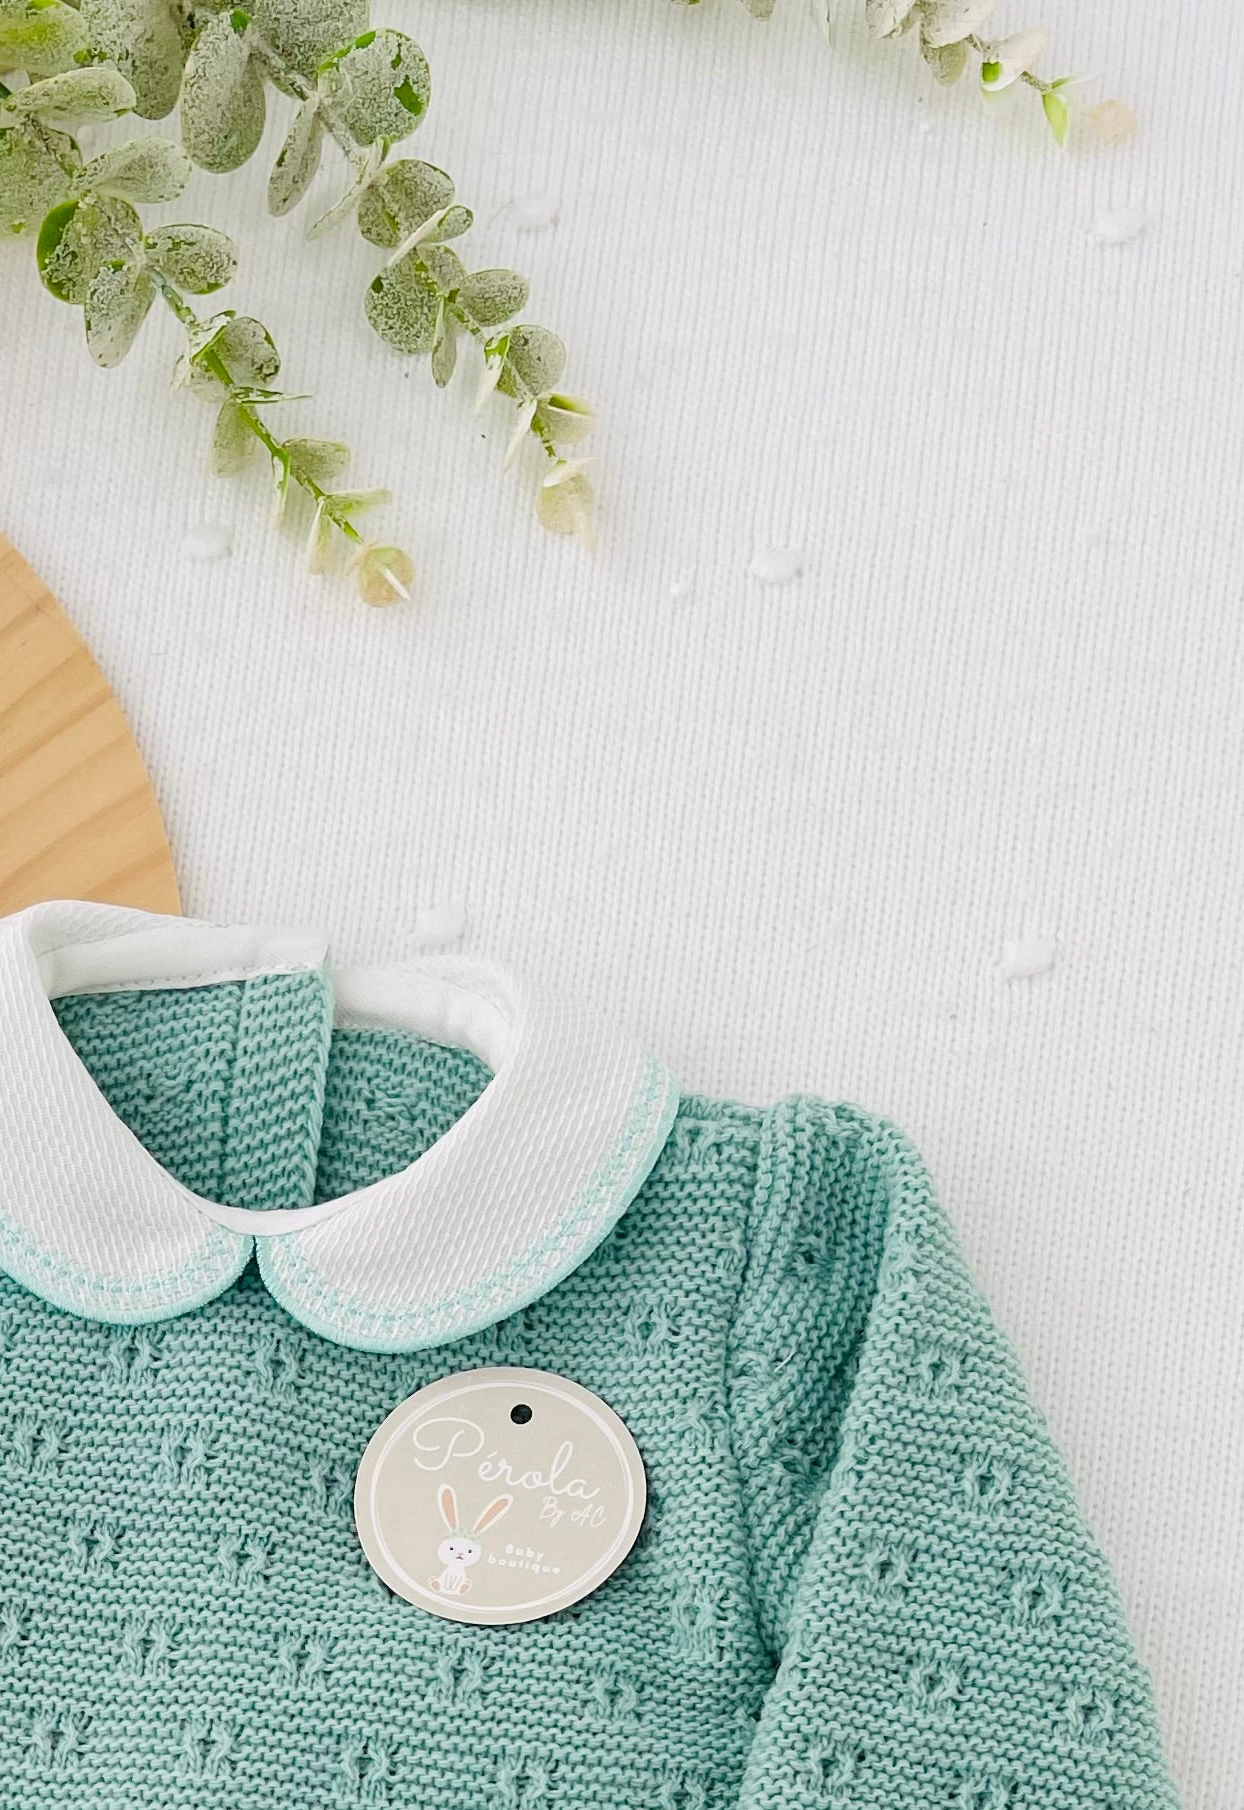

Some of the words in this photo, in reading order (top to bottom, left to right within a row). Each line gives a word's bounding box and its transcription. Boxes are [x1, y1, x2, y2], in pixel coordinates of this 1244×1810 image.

[412, 1416, 601, 1500] Pérola
[539, 1496, 567, 1528] By
[487, 1554, 562, 1575] boutique
[505, 1543, 545, 1562] Baby
